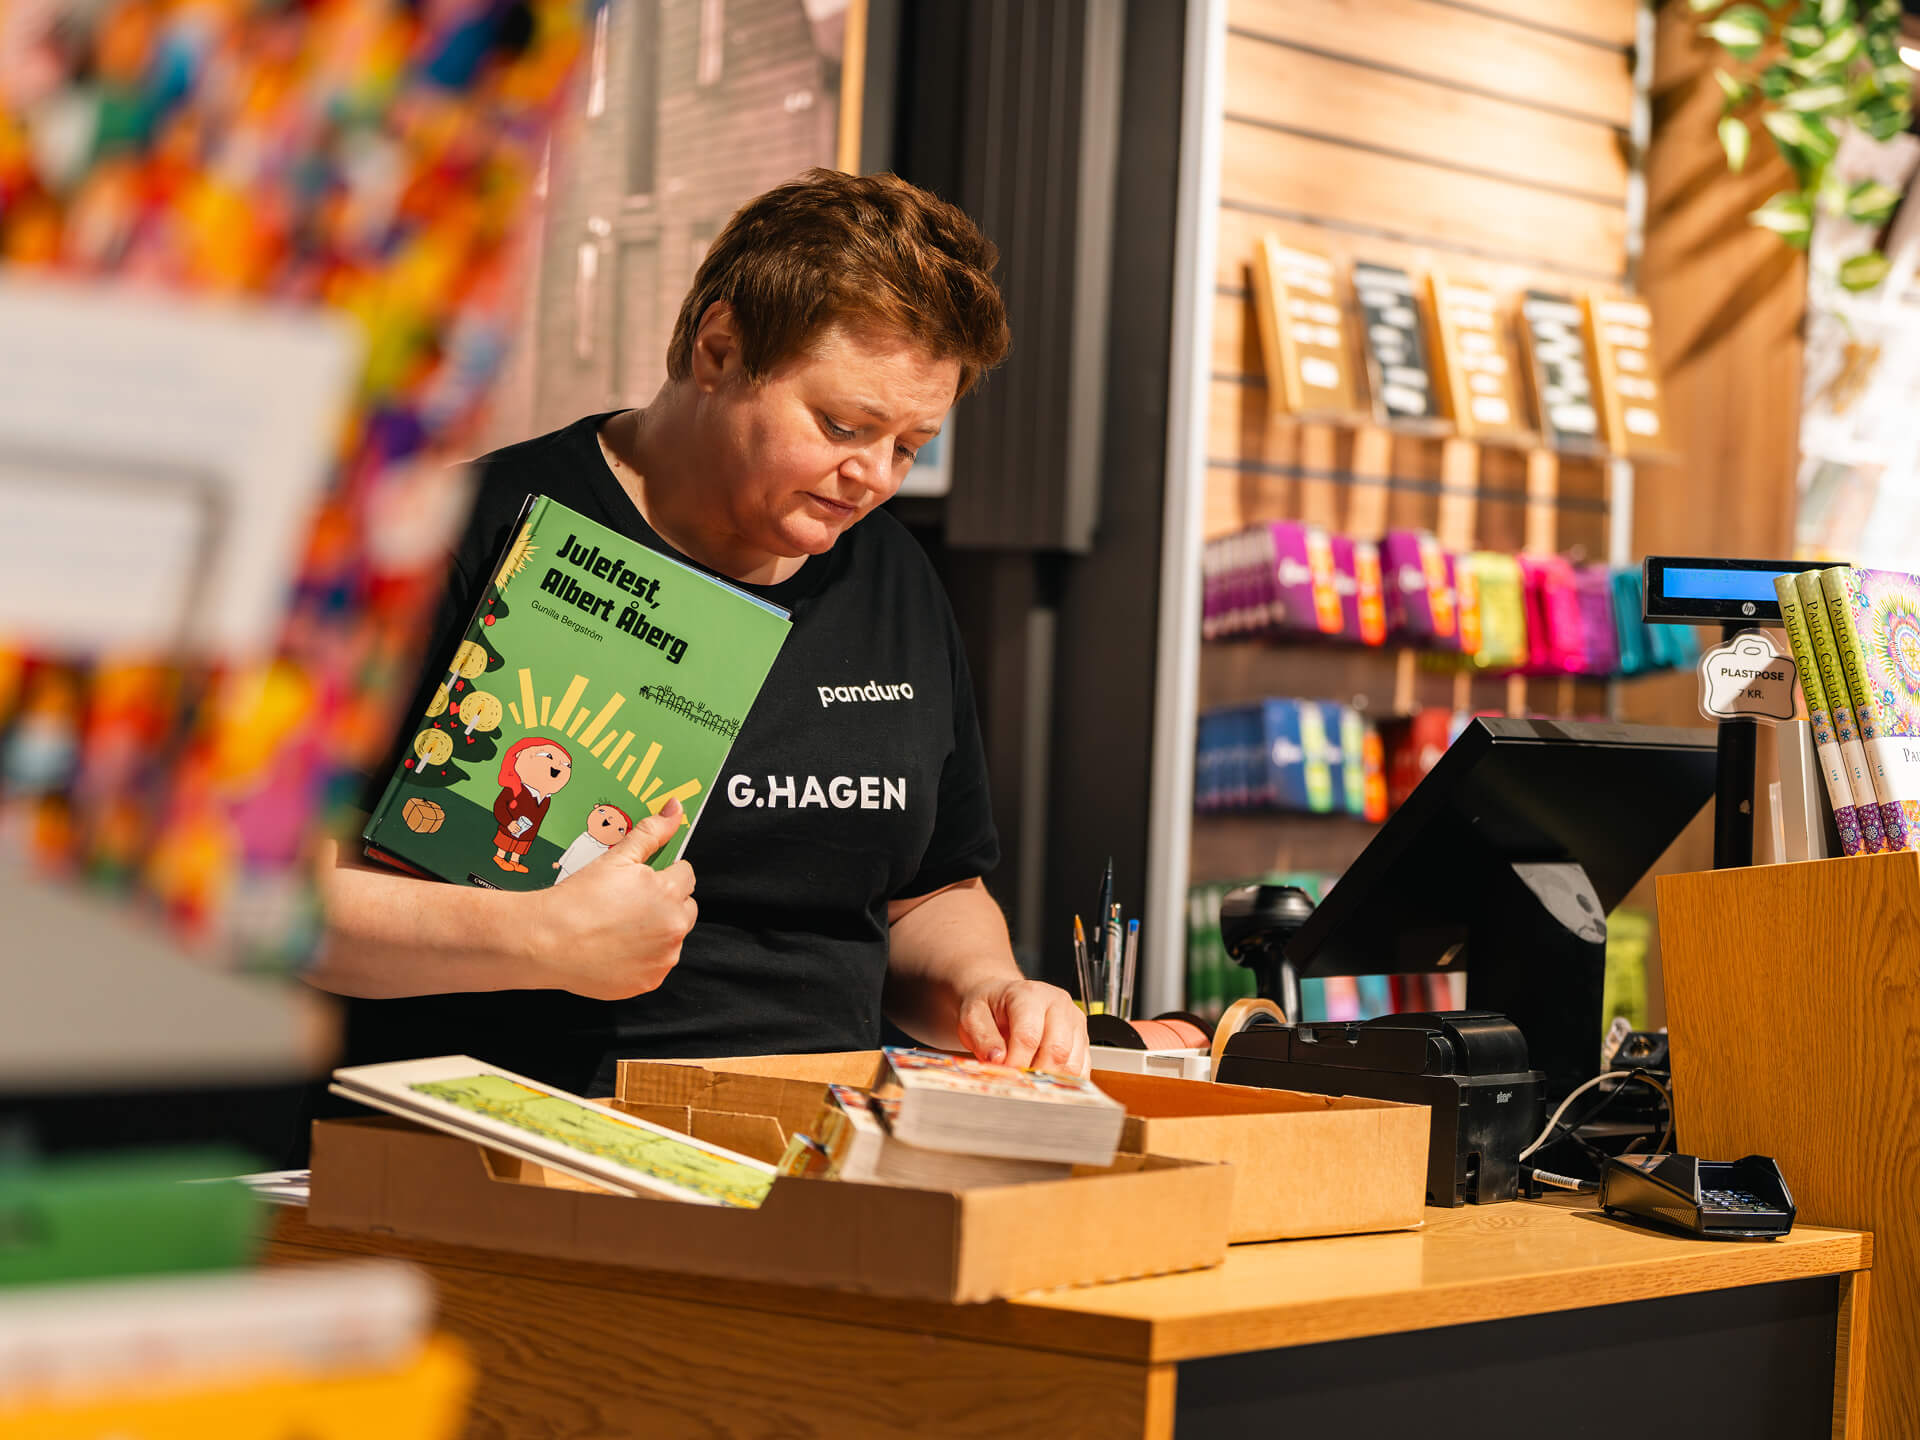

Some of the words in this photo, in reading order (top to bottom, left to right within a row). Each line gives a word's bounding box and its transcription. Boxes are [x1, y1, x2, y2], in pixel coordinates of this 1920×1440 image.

[556, 534, 661, 609] Julefest,
[531, 600, 559, 621] Gunilla
[560, 615, 604, 642] Bergström
[540, 568, 615, 622] Albert
[616, 601, 688, 664] Åberg
[1721, 668, 1785, 681] PLASTPOSE
[817, 680, 914, 708] panduro
[1738, 688, 1745, 697] 7
[1747, 689, 1764, 699] KR.
[727, 774, 906, 811] G.HAGEN
